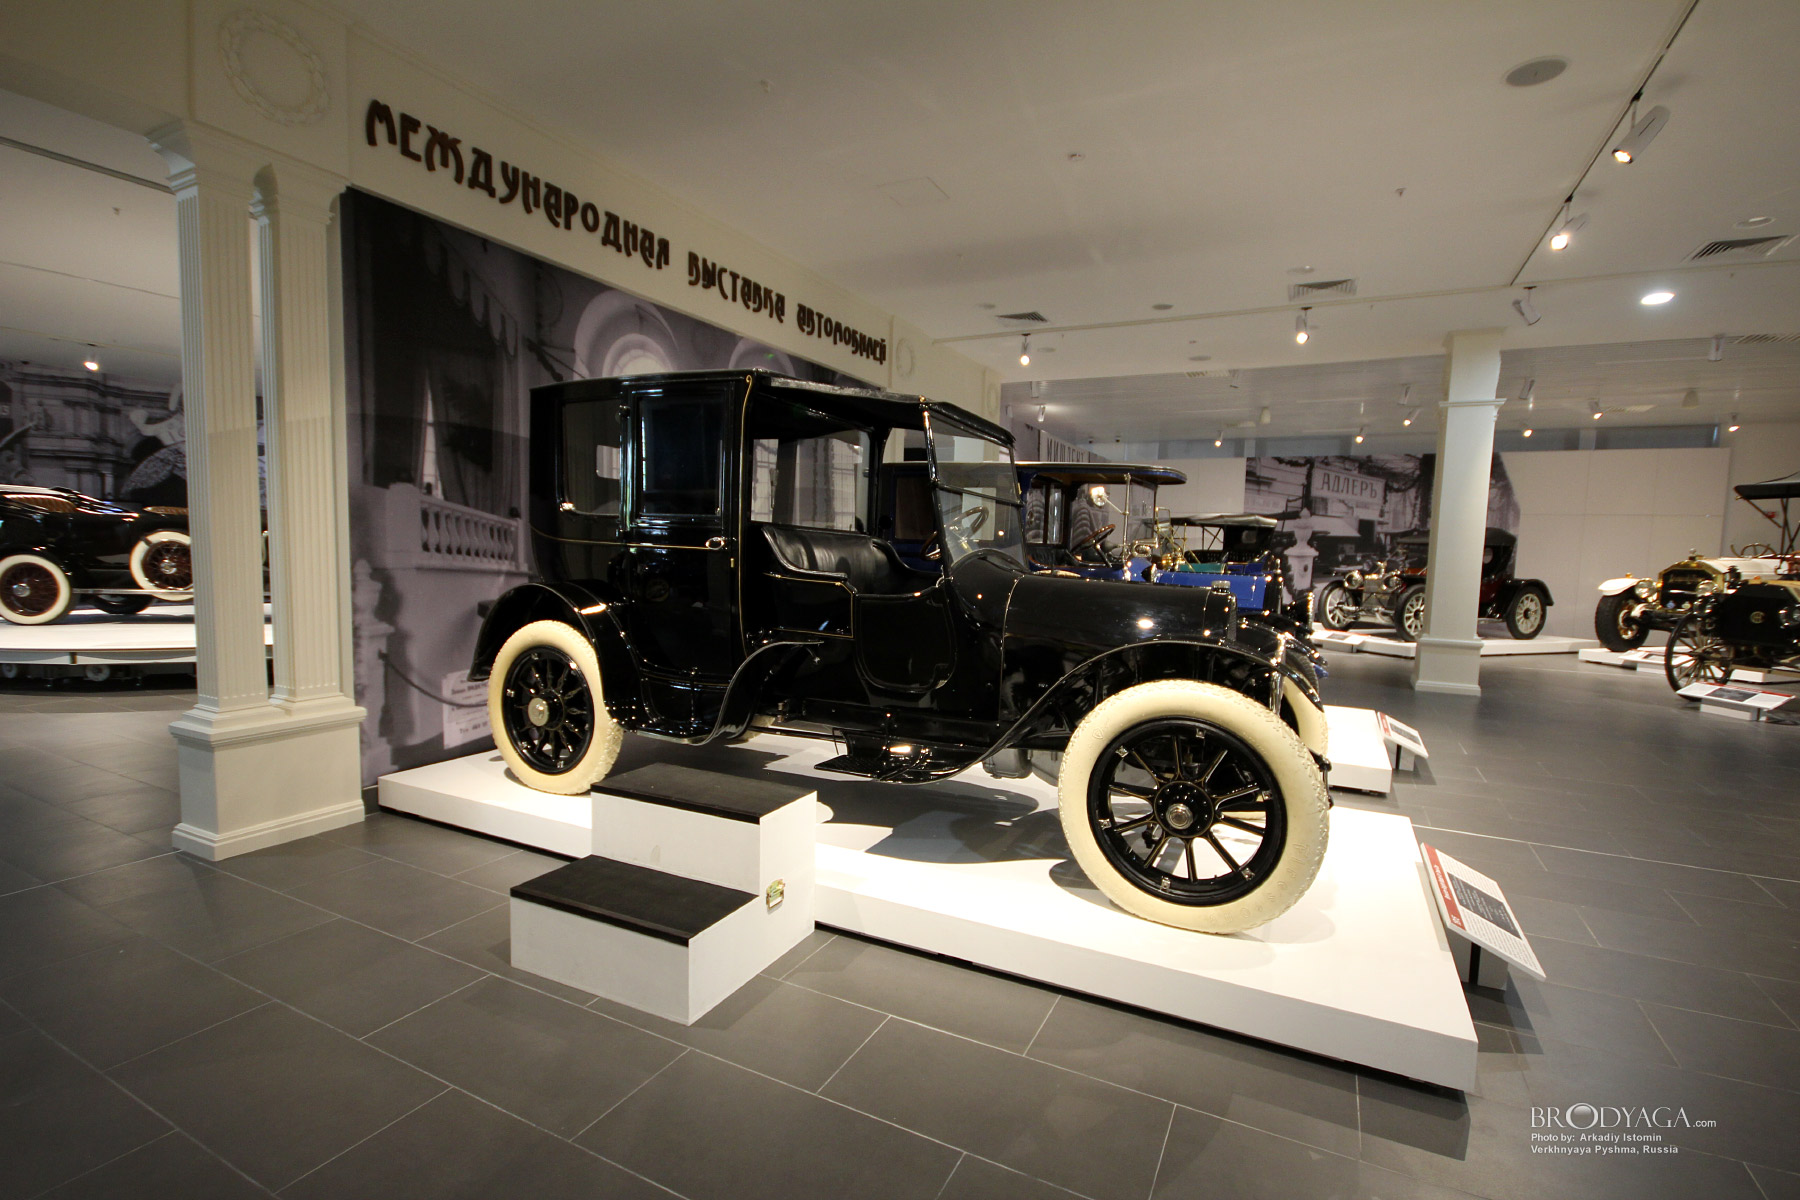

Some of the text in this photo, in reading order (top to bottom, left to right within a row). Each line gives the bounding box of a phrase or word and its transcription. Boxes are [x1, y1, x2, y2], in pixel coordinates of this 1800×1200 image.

[365, 99, 886, 365] МЕЖДУНАРОДНАЯ ВЫСТАВКА АВТОМОБИЛЕЙ
[1320, 472, 1378, 499] АДЛЕРЪ
